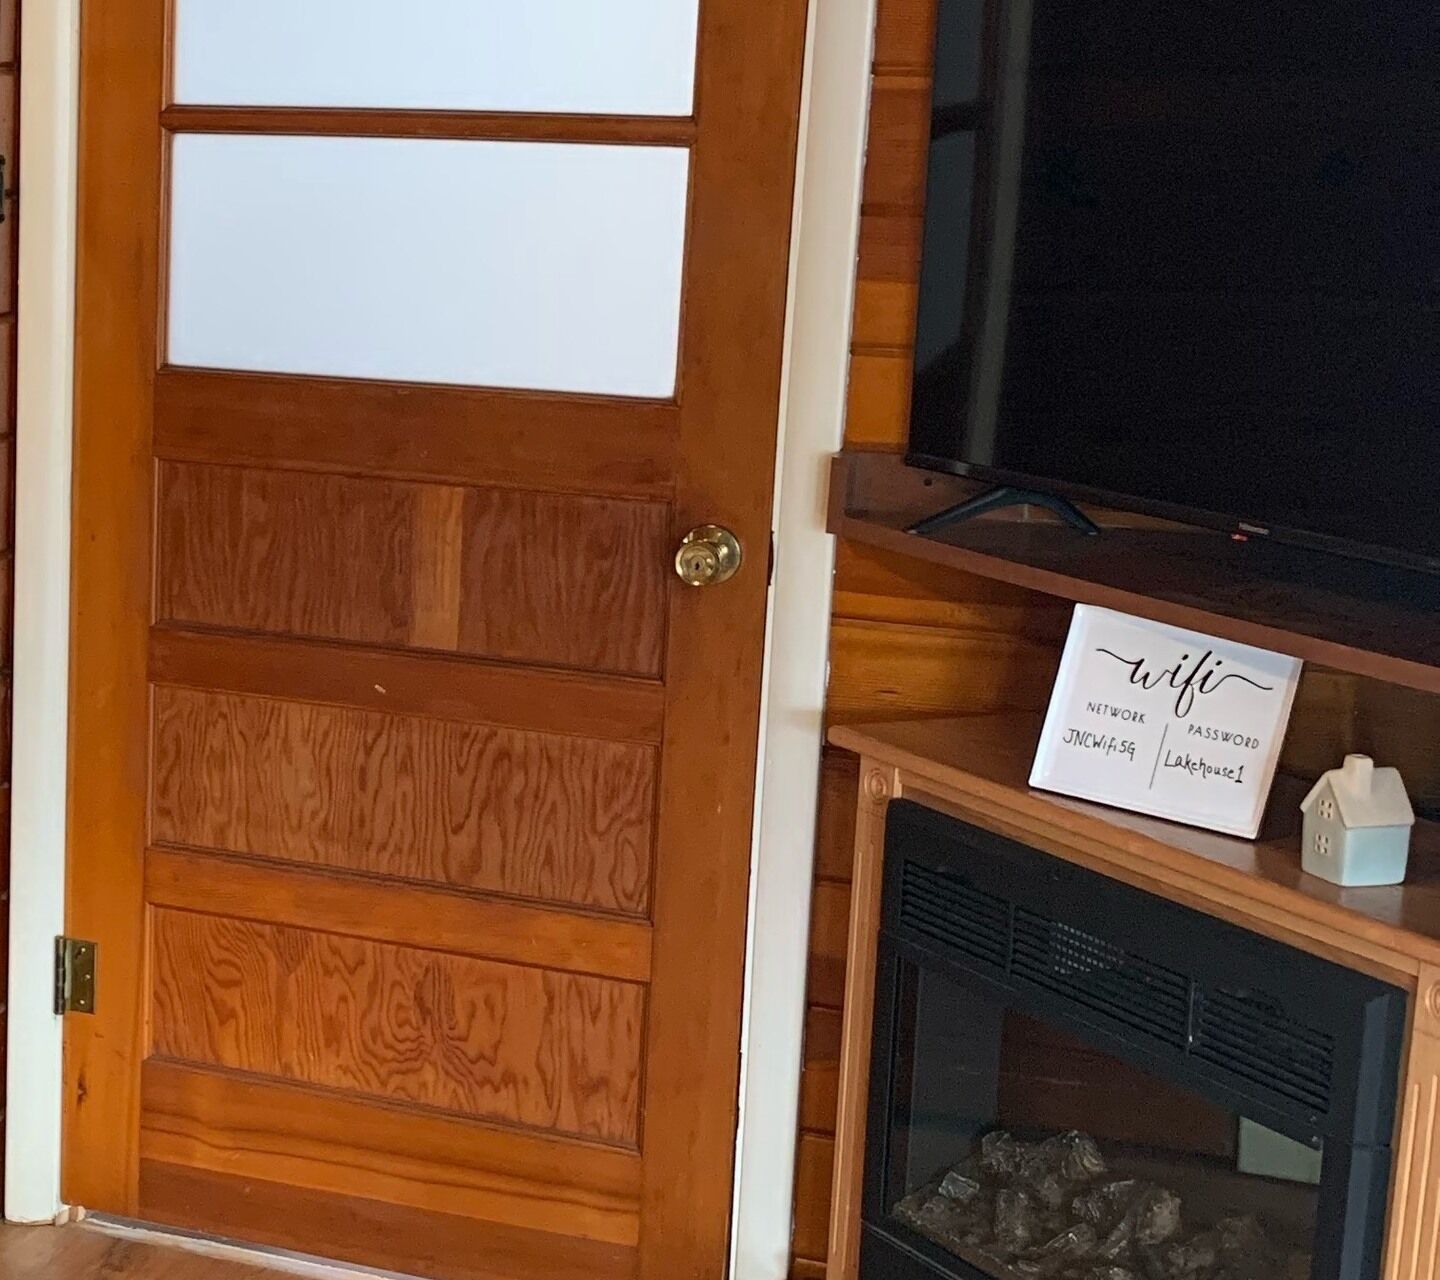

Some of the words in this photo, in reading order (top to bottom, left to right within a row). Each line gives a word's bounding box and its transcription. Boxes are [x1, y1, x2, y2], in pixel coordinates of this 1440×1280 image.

[1096, 649, 1273, 718] wifi
[1087, 701, 1146, 724] NETWORK
[1188, 724, 1259, 750] PASSWORD
